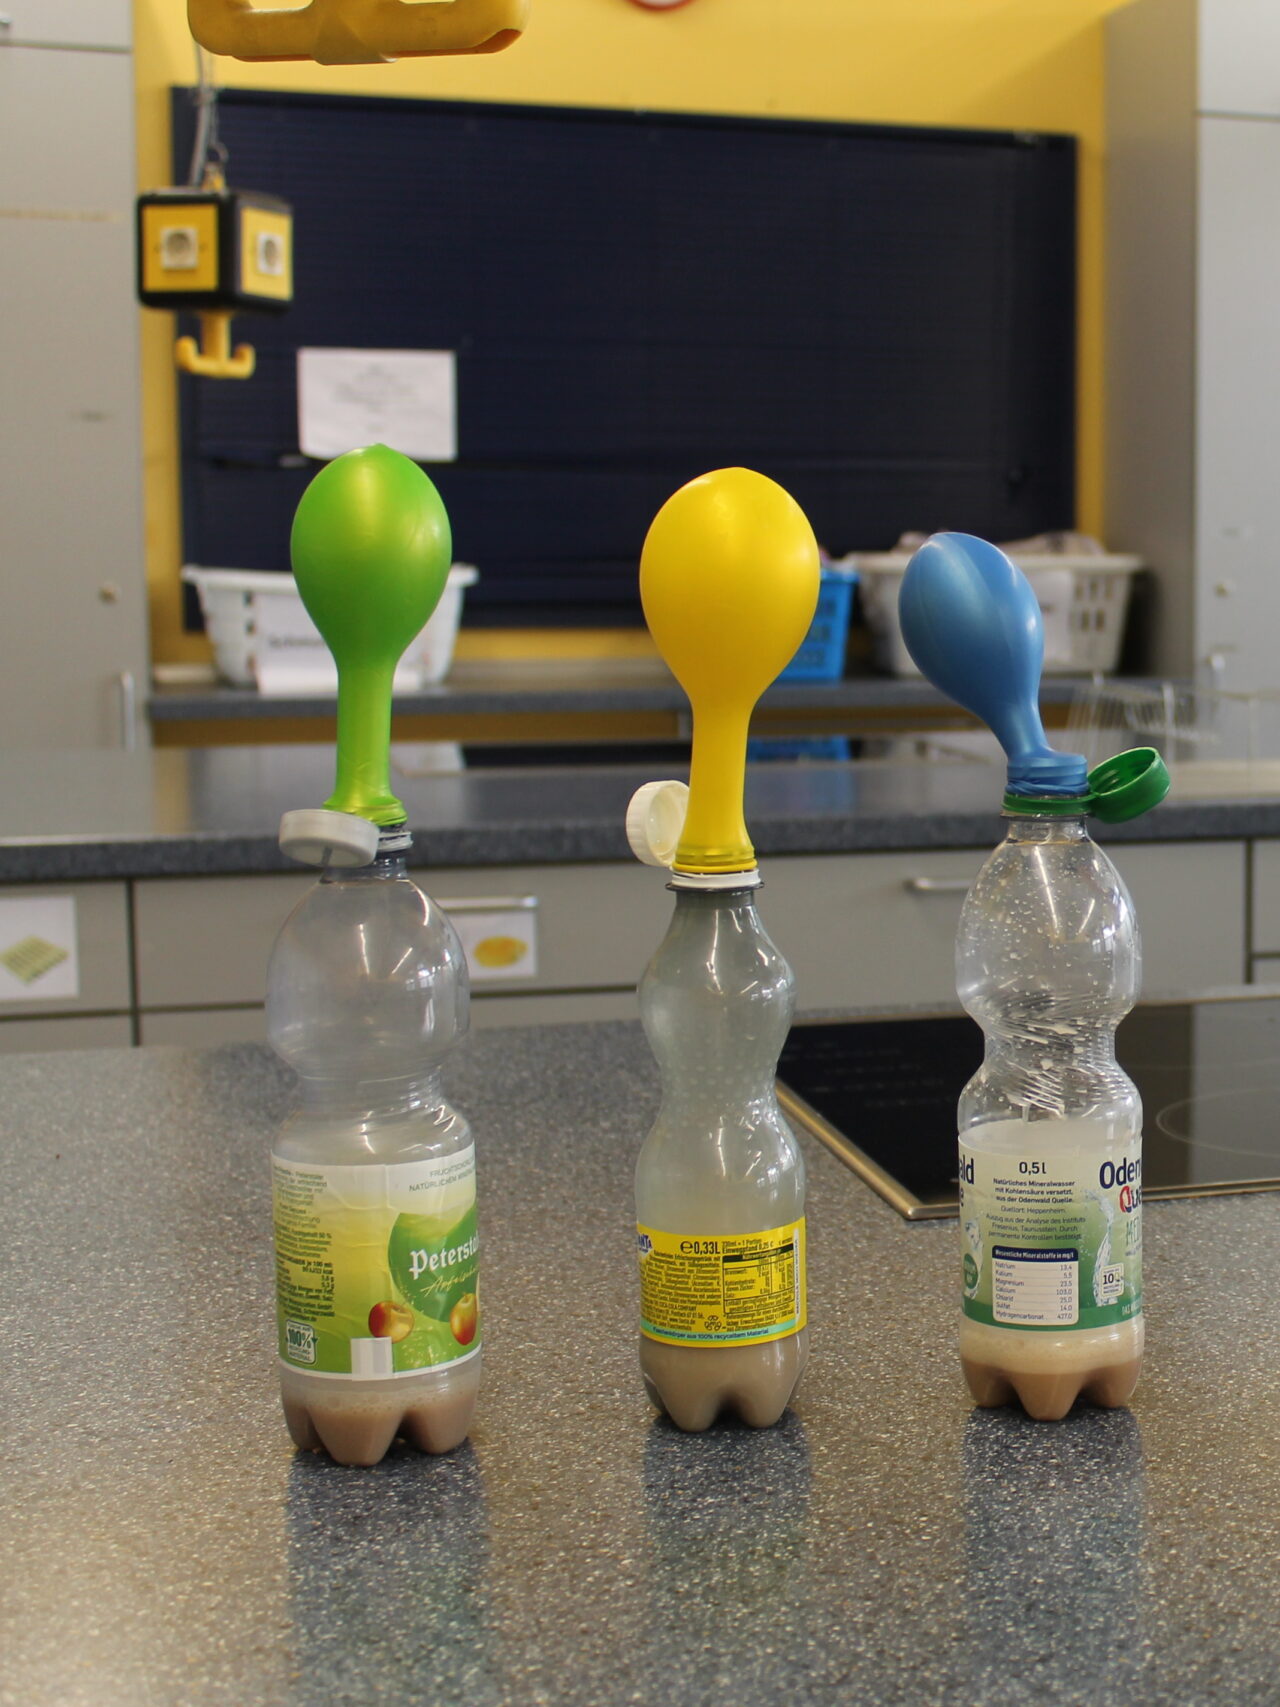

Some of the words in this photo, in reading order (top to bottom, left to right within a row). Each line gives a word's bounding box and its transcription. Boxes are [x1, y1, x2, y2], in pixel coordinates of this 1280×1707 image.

[1019, 1161, 1040, 1175] 0,5
[1028, 1179, 1075, 1187] Mineralwasser
[1018, 1195, 1050, 1204] Odenwald
